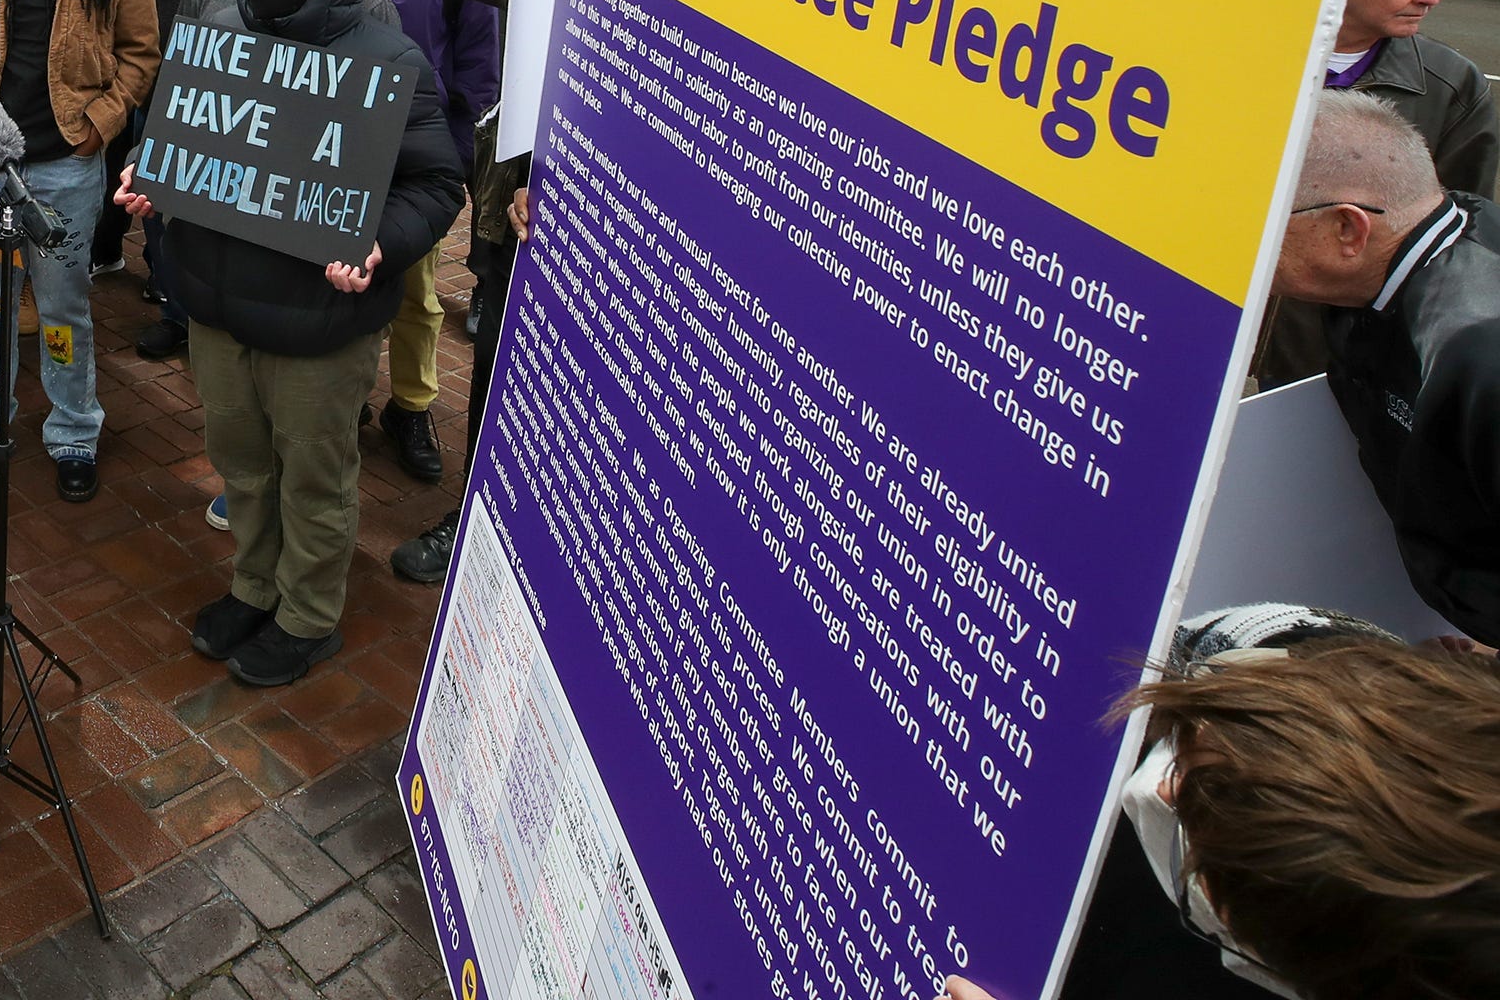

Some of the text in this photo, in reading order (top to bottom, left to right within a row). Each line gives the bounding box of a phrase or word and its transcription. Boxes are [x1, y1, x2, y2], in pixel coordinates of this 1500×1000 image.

[164, 21, 256, 77] MIKE
[262, 42, 353, 99] MAY
[165, 85, 342, 167] HAVE A
[136, 138, 370, 237] LIVABLE WAGE!
[648, 14, 661, 38] to
[659, 19, 684, 48] build
[683, 37, 701, 59] our
[701, 48, 731, 79] union
[729, 61, 778, 111] because
[776, 95, 799, 119] we
[797, 102, 826, 138] love
[828, 128, 856, 155] our
[854, 138, 894, 178] jobs
[893, 167, 928, 201] and
[932, 188, 958, 222] we
[962, 201, 1005, 249] love
[1010, 239, 1064, 287] each
[1071, 276, 1147, 342] other.
[538, 201, 1021, 809] dignity and respect. Our priorities have been developed through conversations with our
[547, 128, 1060, 676] by the respect and recognition of our colleagues’ humanity, regardless of their eligibility in
[524, 282, 968, 970] The only way forward is together. We as Organizing Committee Members commit to
[419, 816, 460, 951] 877-YES-NCFO
